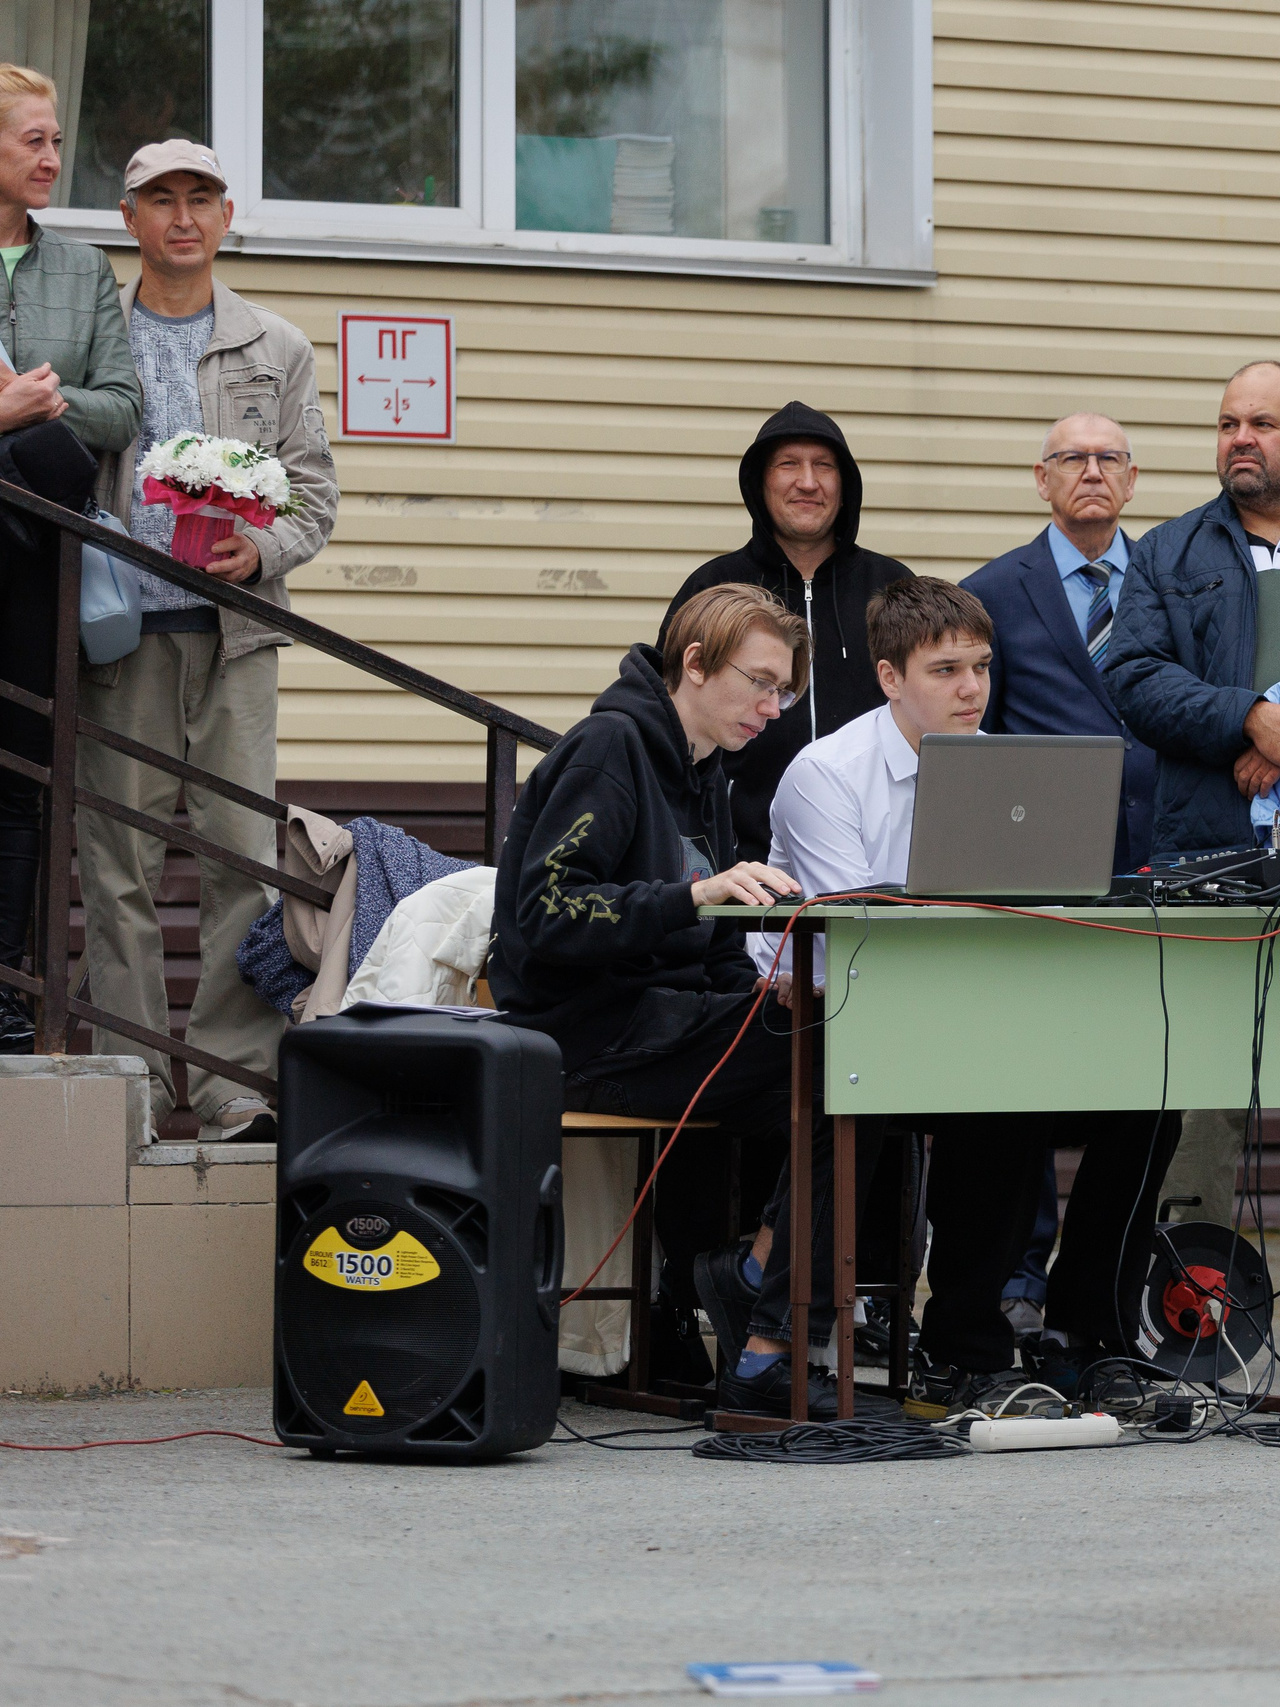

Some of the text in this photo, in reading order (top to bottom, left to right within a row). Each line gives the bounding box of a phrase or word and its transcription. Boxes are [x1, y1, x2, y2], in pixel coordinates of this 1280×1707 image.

[378, 329, 417, 360] ПГ
[383, 397, 411, 411] 2 5
[1011, 805, 1026, 822] hp
[353, 1217, 383, 1231] 1500
[309, 1250, 334, 1259] EUROLIVE
[335, 1252, 393, 1277] 1500
[345, 1275, 380, 1286] WATTS
